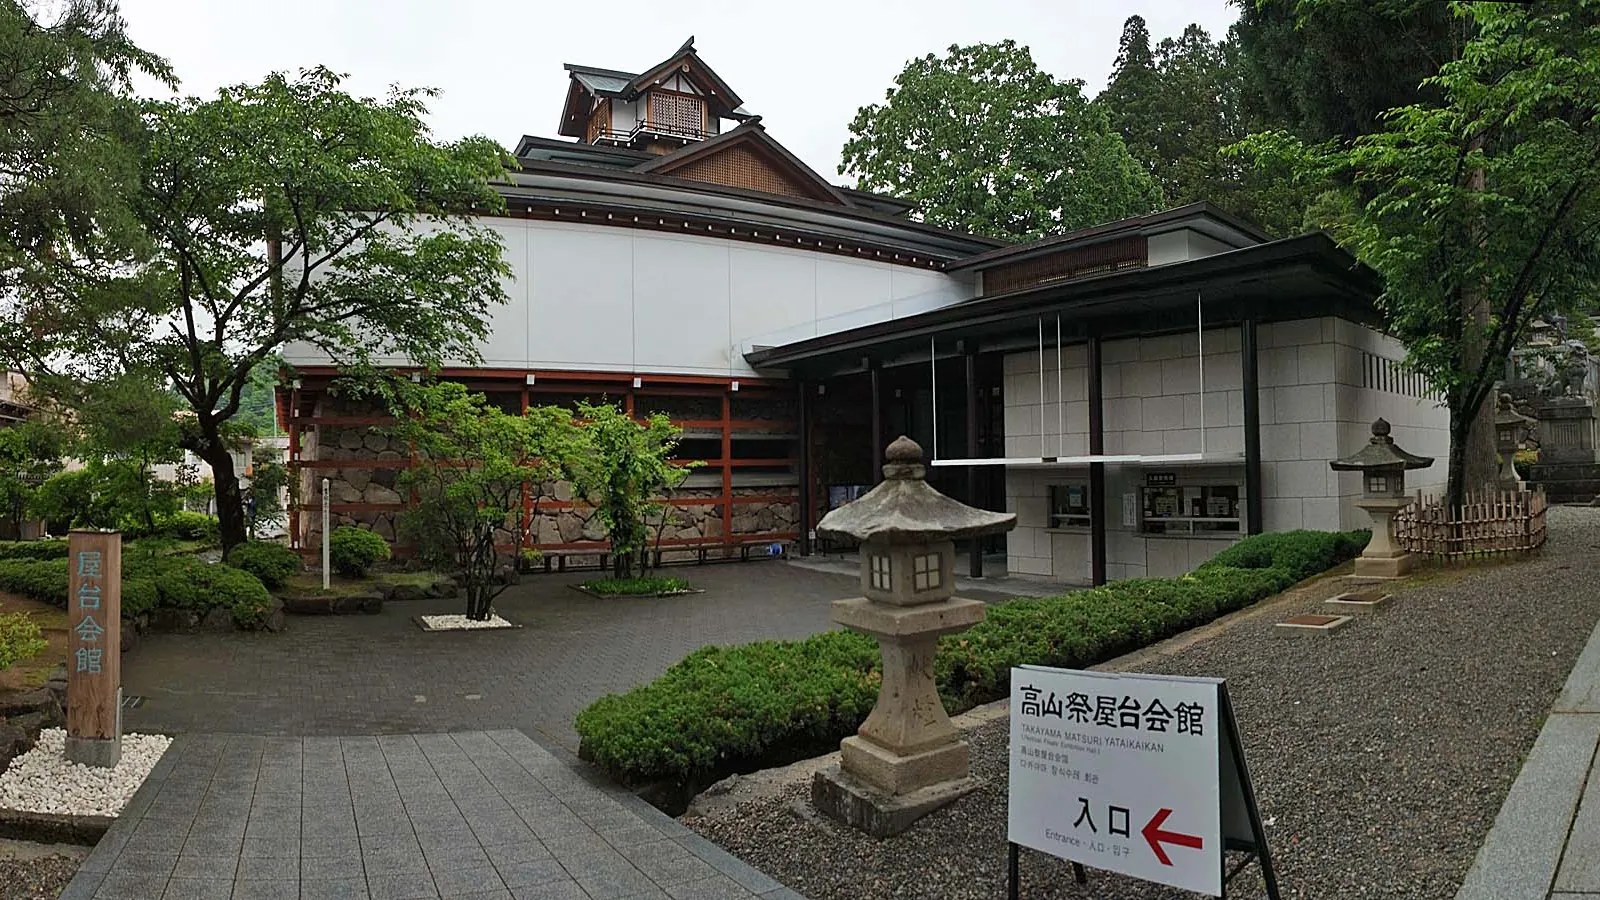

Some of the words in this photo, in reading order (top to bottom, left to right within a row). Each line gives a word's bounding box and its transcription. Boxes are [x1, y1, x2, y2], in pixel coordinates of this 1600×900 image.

[75, 551, 104, 673] 屋台会館
[1020, 684, 1204, 736] 高山祭屋台会館
[1022, 724, 1062, 738] TAKAYAMA
[1064, 731, 1102, 746] MATSURI
[1104, 736, 1164, 753] YATAIKAIKAN
[1045, 829, 1080, 847] Entrance
[1073, 797, 1130, 838] 入口
